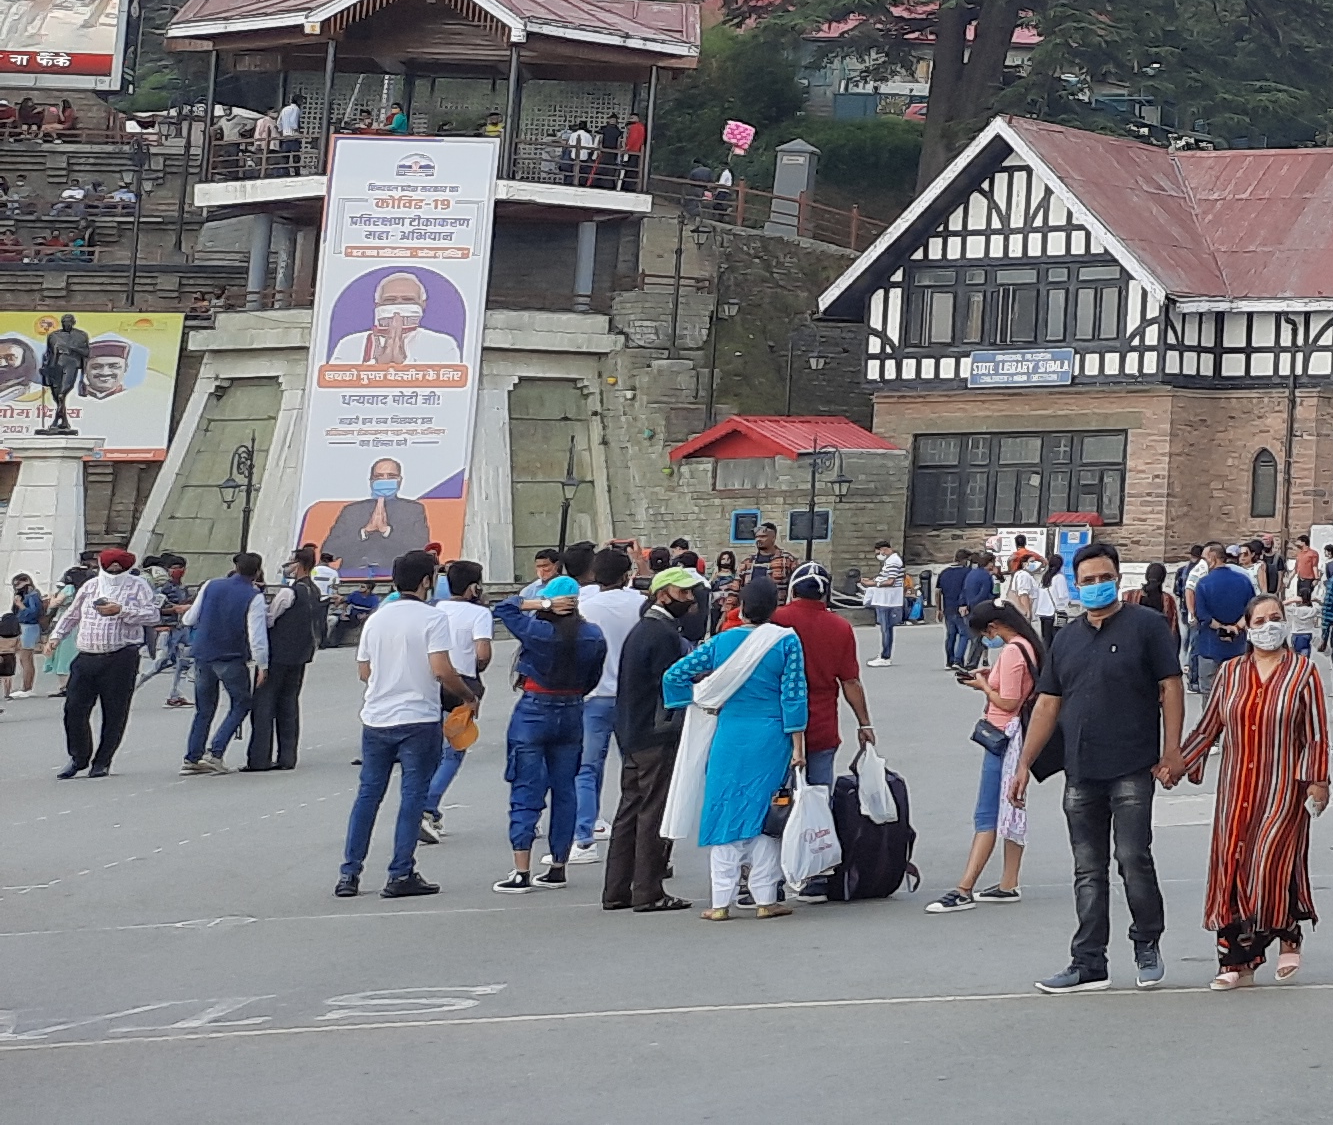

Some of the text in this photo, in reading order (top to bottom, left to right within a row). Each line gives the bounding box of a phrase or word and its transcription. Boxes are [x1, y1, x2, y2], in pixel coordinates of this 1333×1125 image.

[374, 195, 451, 210] कोविड-19
[349, 214, 471, 228] प्रतिरक्षण टीकाकरण
[400, 228, 455, 242] अभियान
[973, 362, 996, 374] STATE
[999, 361, 1037, 373] LIBRARY
[341, 394, 390, 406] धन्यवाद
[392, 391, 418, 406] मोदी
[36, 404, 82, 419] दिस
